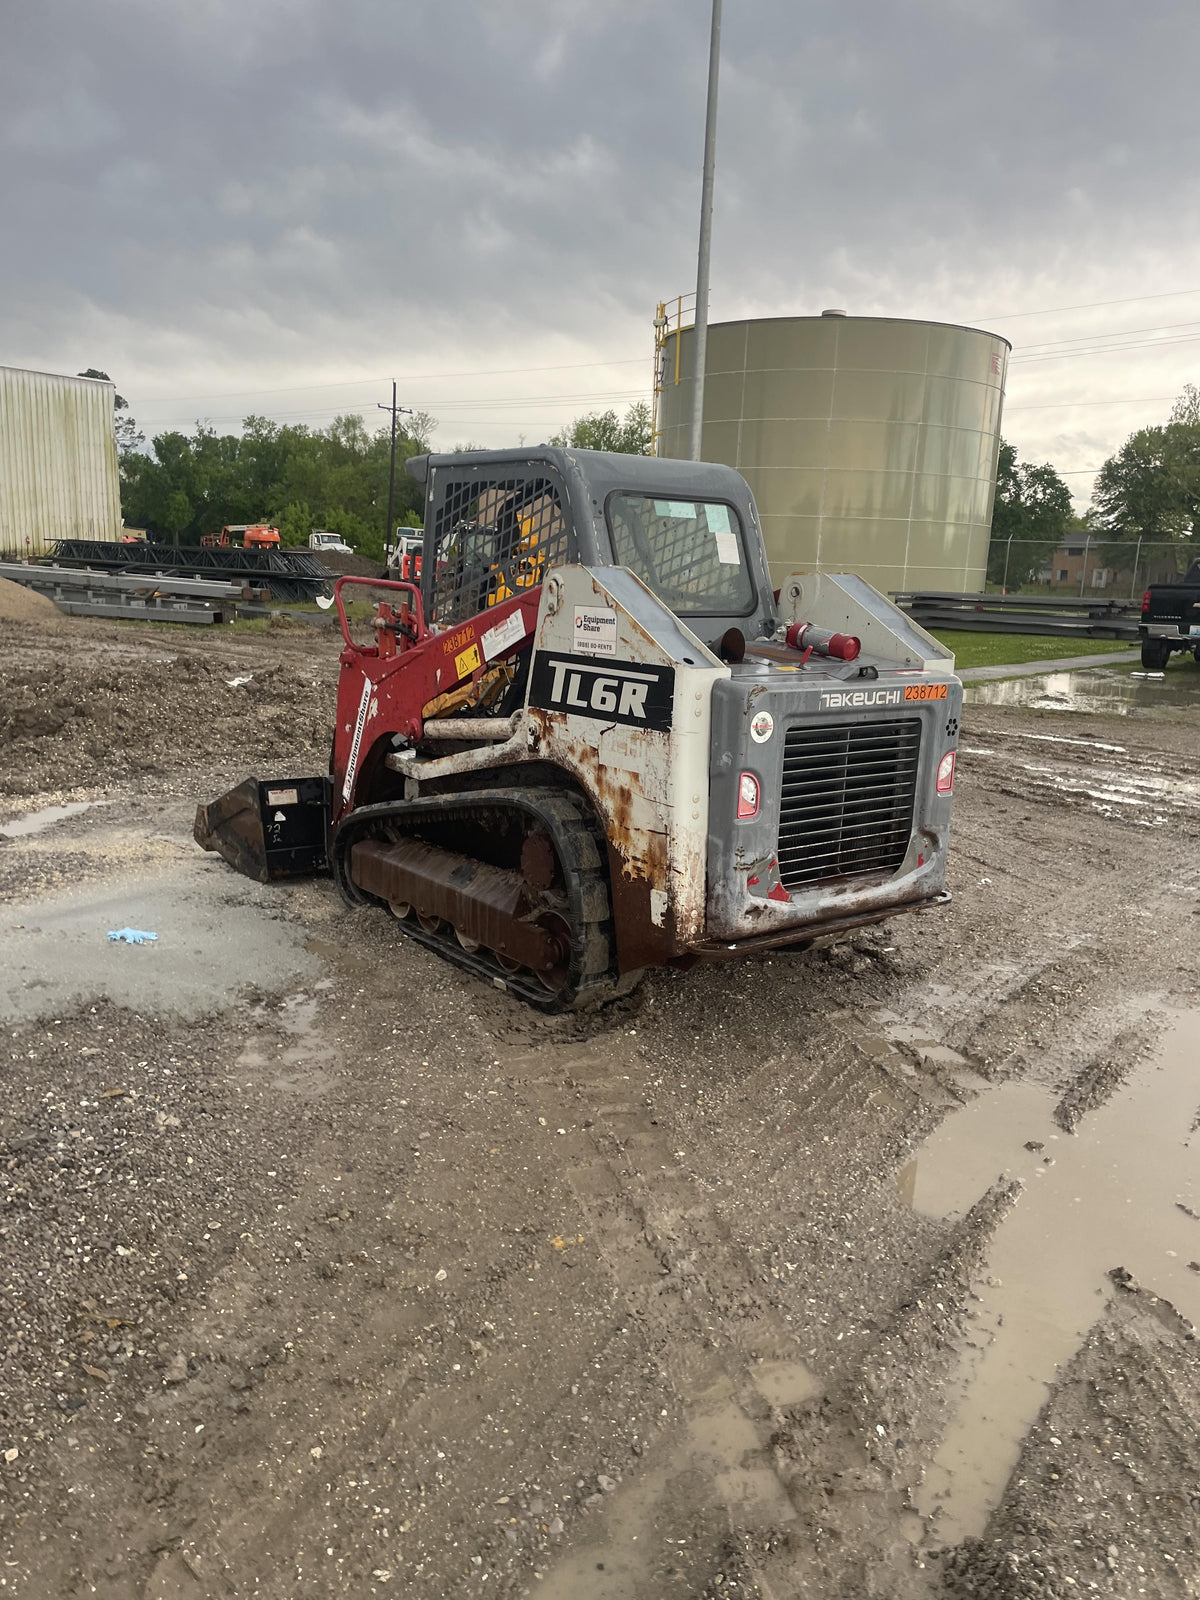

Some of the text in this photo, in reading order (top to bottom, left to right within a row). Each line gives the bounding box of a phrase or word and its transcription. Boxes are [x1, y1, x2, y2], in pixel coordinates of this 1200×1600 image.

[583, 614, 616, 625] Equipment
[583, 623, 601, 632] Share
[442, 625, 474, 654] 238712
[548, 660, 660, 719] TL6R
[905, 684, 948, 701] 238712
[347, 690, 369, 778] EquipmentShare
